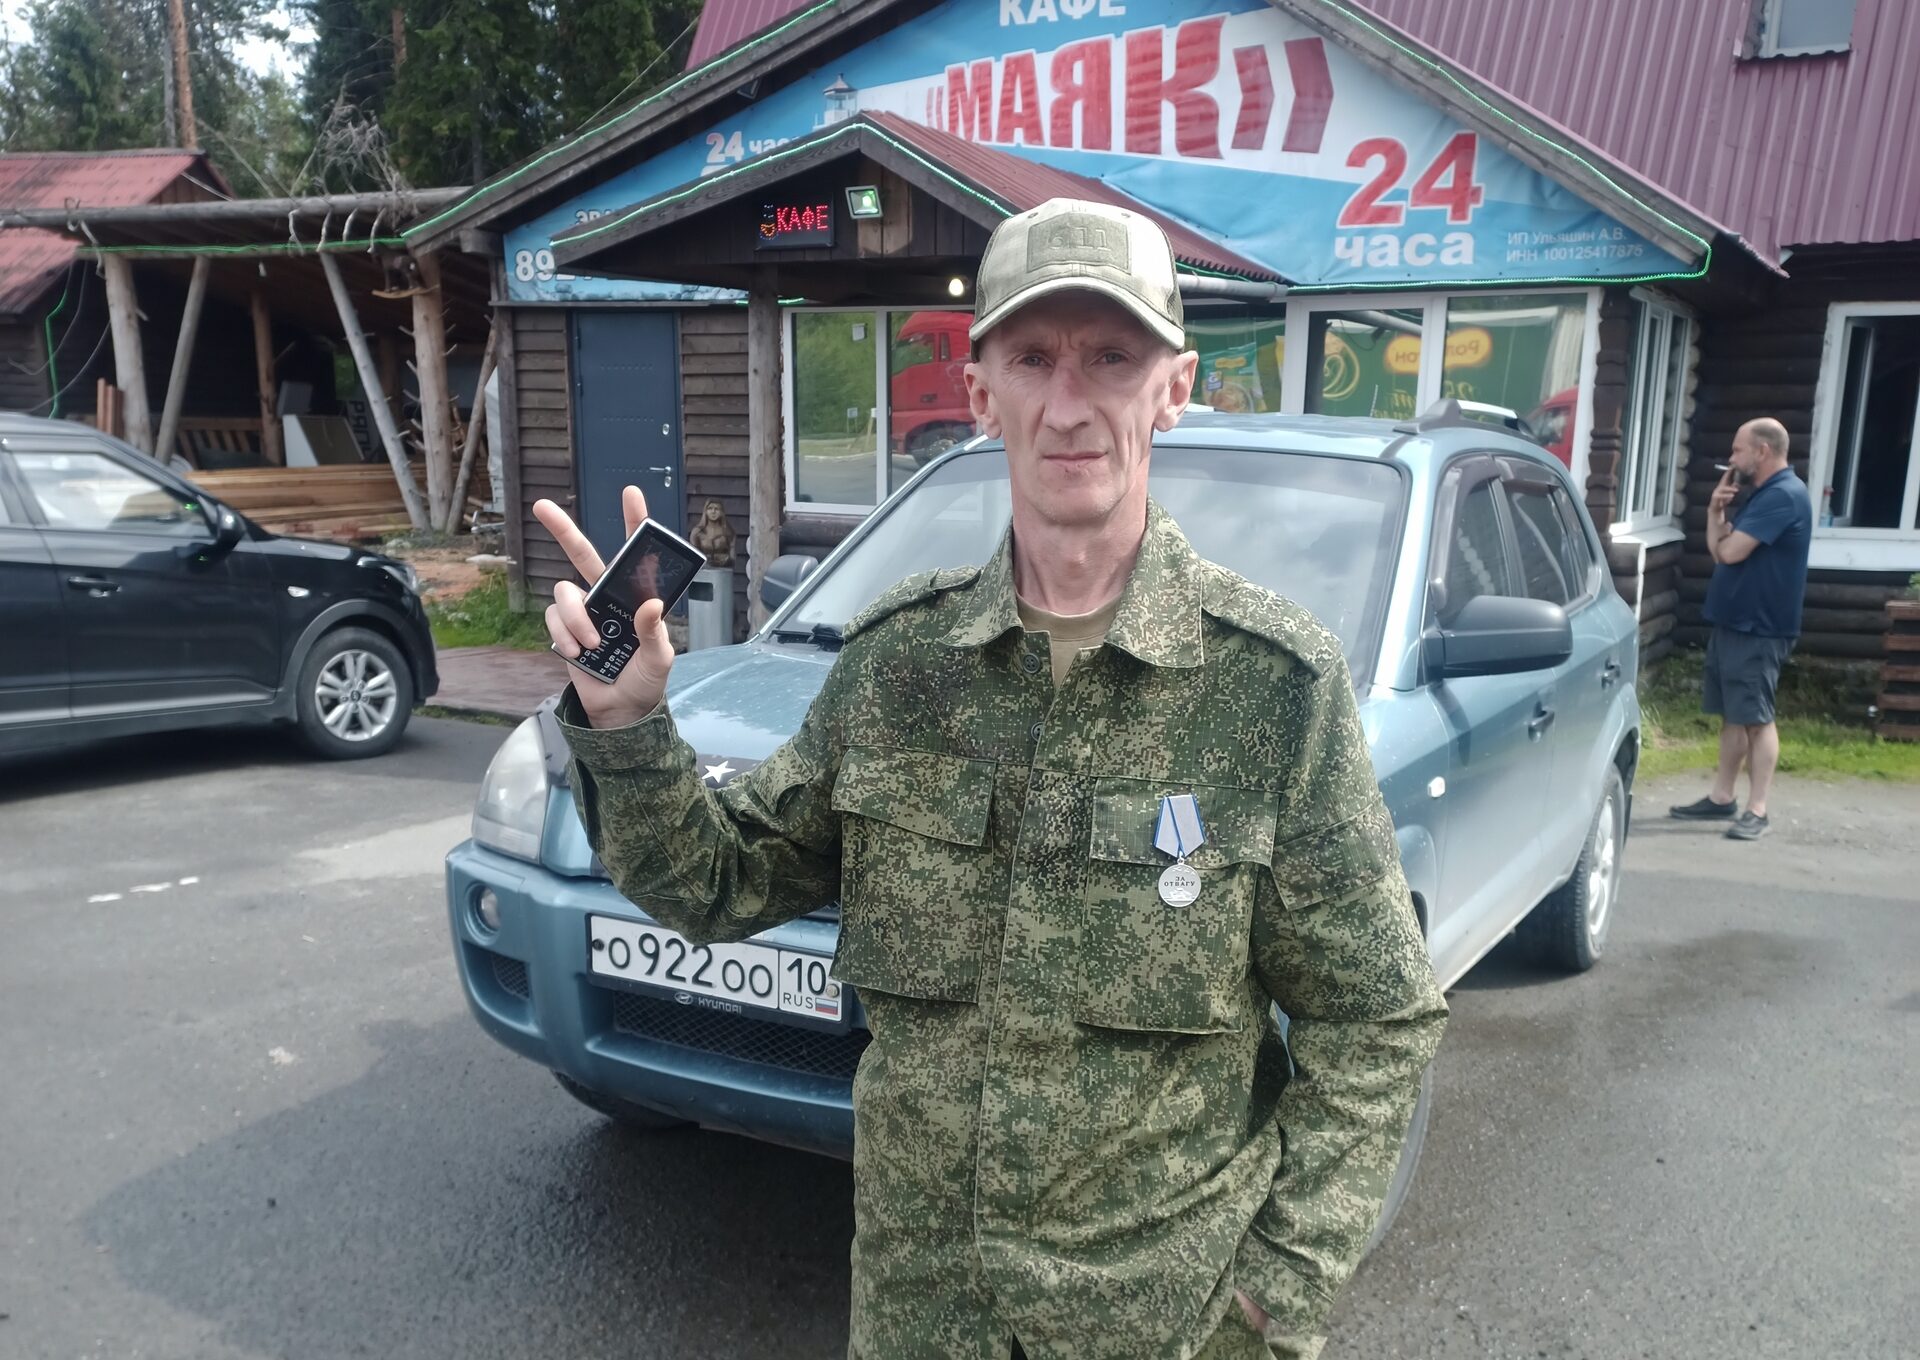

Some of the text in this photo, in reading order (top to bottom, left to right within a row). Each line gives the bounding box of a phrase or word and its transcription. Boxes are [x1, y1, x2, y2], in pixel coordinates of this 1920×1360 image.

[706, 131, 744, 163] 24
[1337, 131, 1483, 228] 24
[776, 205, 828, 231] КАФЕ
[1334, 231, 1475, 267] часа
[1507, 231, 1528, 245] ИП
[1506, 248, 1538, 263] ИНН
[607, 603, 634, 622] MAXV
[786, 957, 827, 995] 10
[698, 996, 742, 1014] HYUNDAI
[783, 994, 813, 1009] RUS
